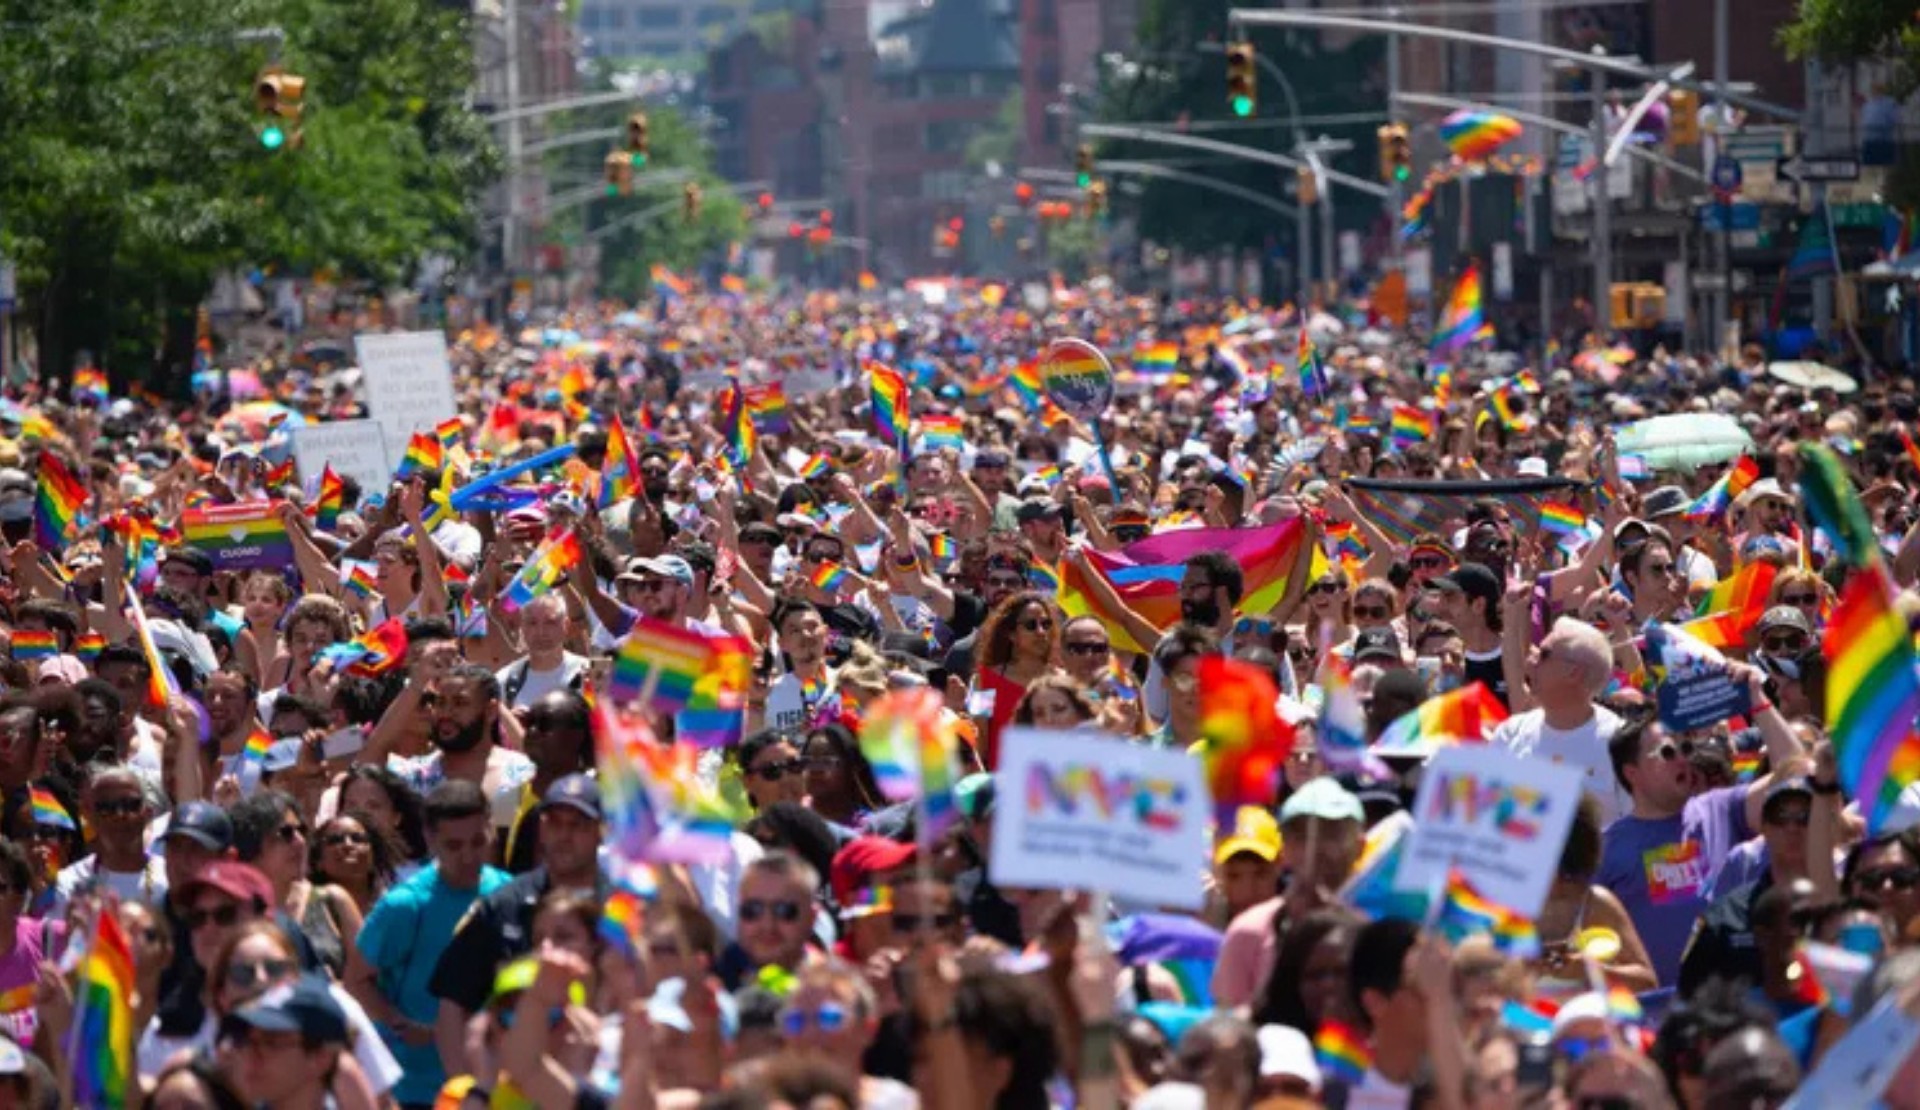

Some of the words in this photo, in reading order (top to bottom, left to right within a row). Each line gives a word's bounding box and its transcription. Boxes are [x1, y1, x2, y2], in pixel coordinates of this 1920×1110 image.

[220, 546, 262, 558] CUOMO
[1026, 760, 1187, 832] NYC
[1427, 771, 1549, 842] NYC
